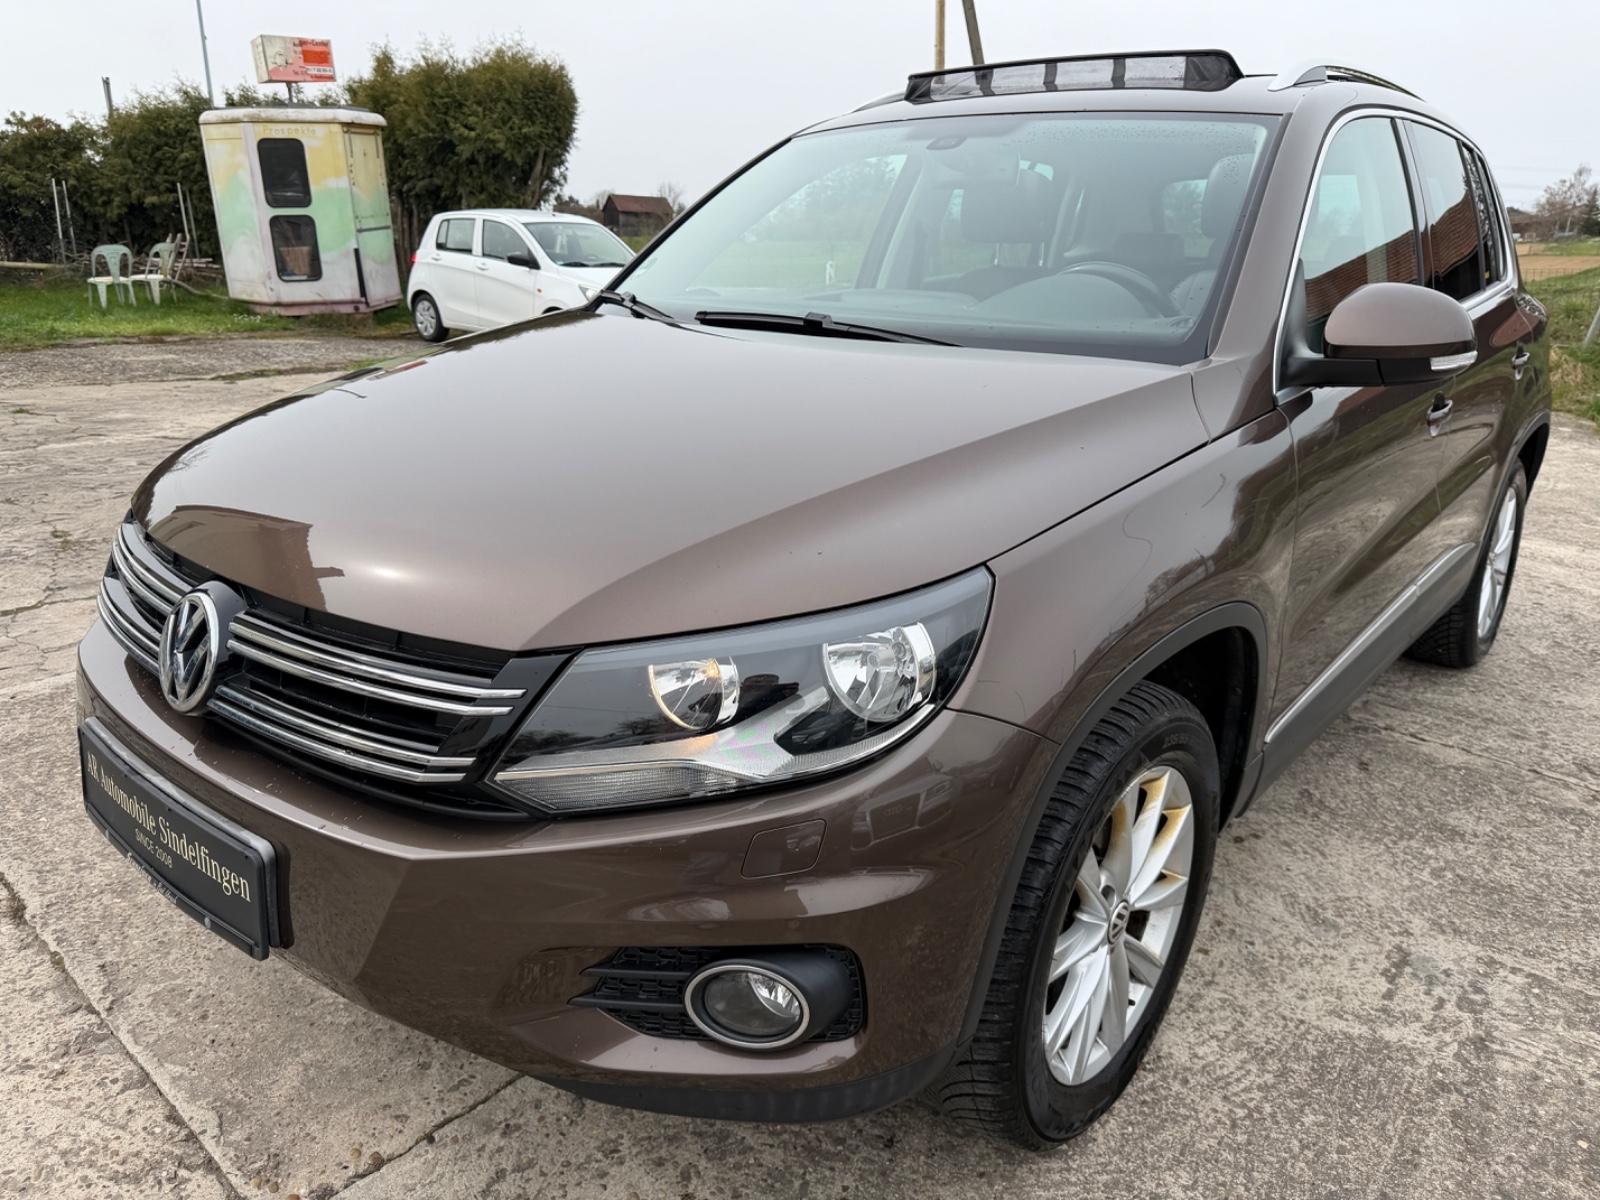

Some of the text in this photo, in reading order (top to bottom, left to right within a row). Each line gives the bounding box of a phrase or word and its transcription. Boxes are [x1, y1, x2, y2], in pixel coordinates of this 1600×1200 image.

[87, 751, 100, 783] AR
[100, 765, 157, 835] Automobile
[158, 816, 251, 902] Sindelfingen
[136, 828, 154, 855] SINCE
